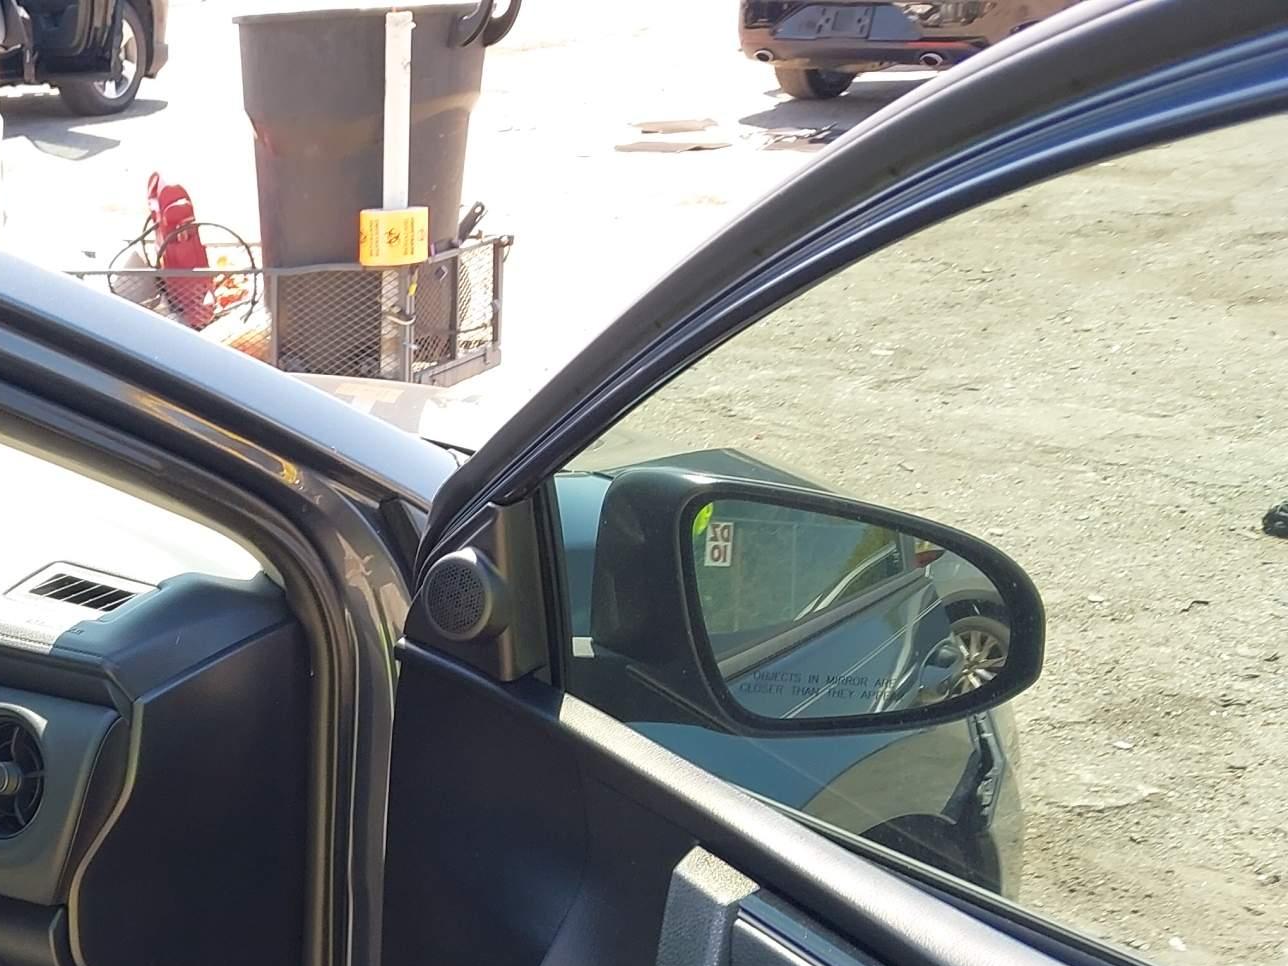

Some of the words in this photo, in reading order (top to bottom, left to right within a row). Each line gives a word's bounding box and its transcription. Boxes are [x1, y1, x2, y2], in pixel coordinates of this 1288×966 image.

[753, 671, 801, 683] OBJECTS
[808, 674, 819, 684] IN
[825, 676, 868, 687] MIRROR
[739, 682, 783, 695] CLOSER
[792, 686, 820, 697] THAN
